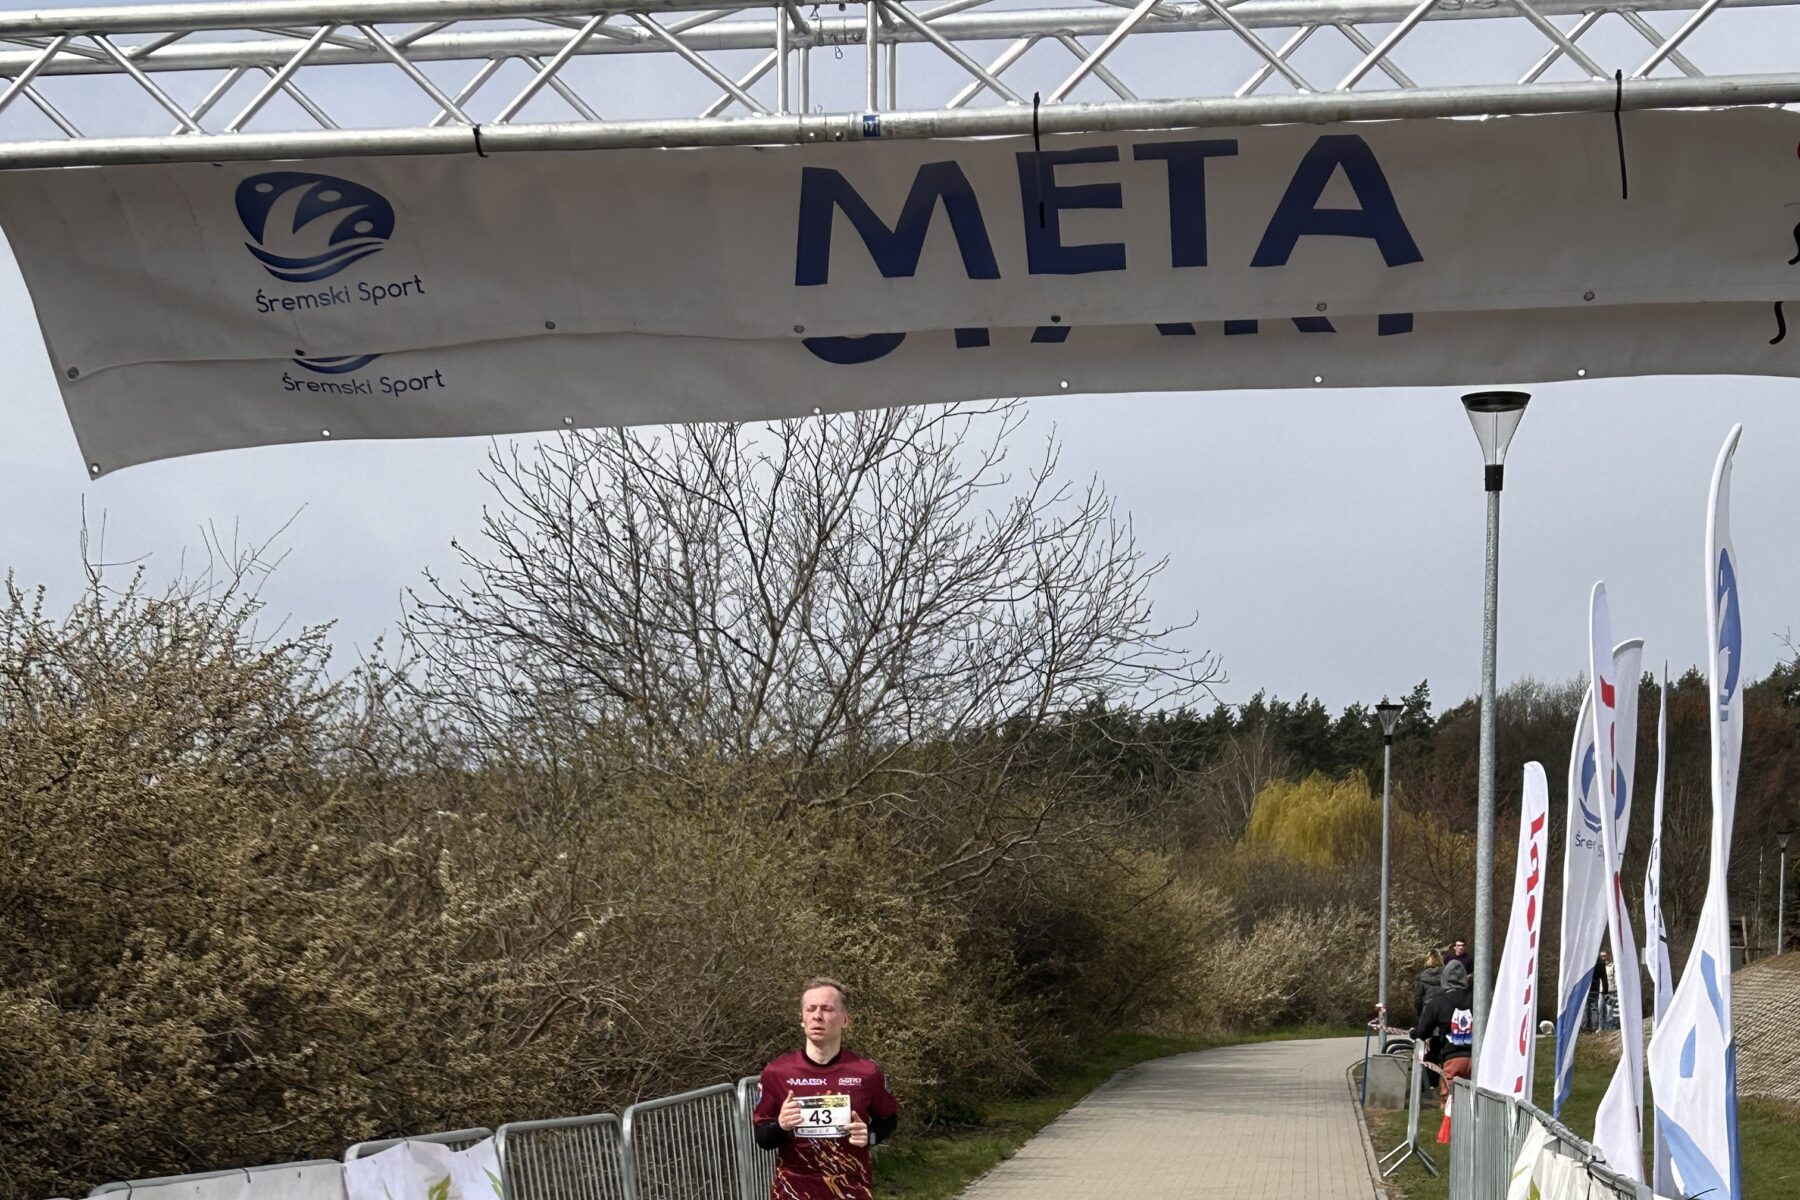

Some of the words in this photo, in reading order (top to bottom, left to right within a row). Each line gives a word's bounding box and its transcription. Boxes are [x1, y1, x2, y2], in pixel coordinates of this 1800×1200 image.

[795, 134, 1424, 286] META
[255, 286, 351, 313] Śremski
[358, 274, 426, 306] Sport
[282, 372, 373, 395] Śremski
[380, 369, 446, 398] Sport
[809, 1109, 833, 1126] 43
